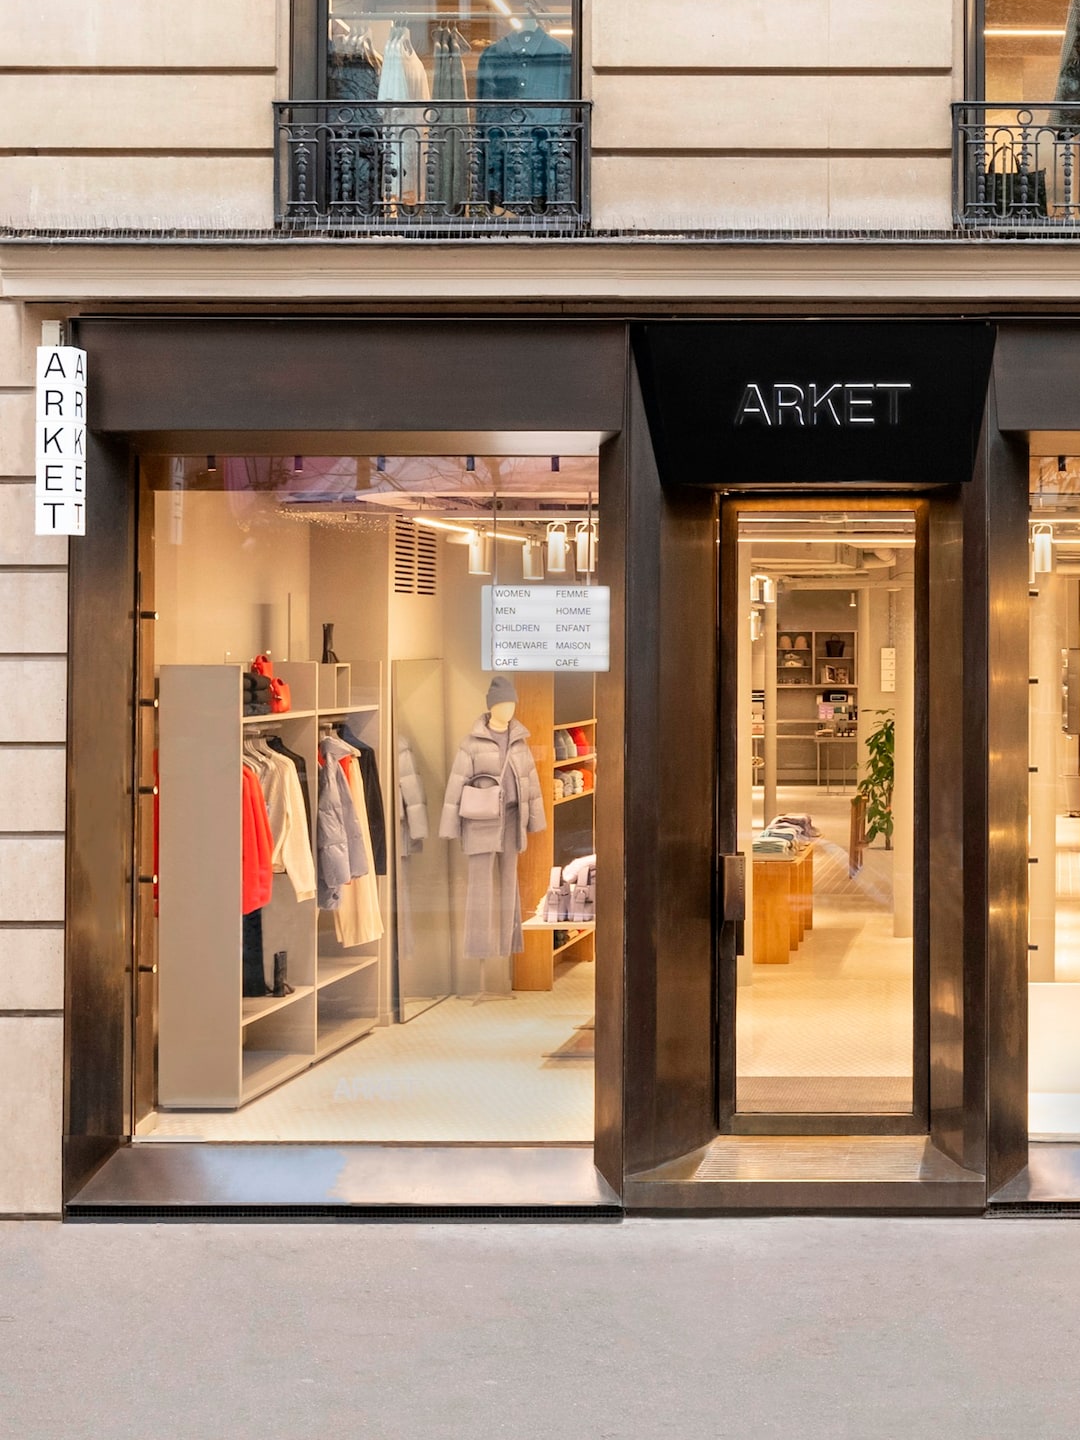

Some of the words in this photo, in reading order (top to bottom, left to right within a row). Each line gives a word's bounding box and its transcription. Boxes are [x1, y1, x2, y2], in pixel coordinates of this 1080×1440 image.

[733, 382, 912, 426] ARKET
[43, 352, 66, 529] ARKET
[74, 353, 84, 529] ARKET
[495, 589, 531, 598] WOMEN
[555, 590, 589, 598] FEMME
[495, 607, 516, 615] MEN
[555, 607, 591, 616] HOMME
[495, 624, 540, 632] CHILDREN
[555, 624, 591, 632] ENFANT
[495, 641, 548, 650] HOMEWARE
[555, 641, 591, 650] MAISON
[495, 657, 519, 666] CAFÉ
[555, 657, 579, 667] CAFÉ
